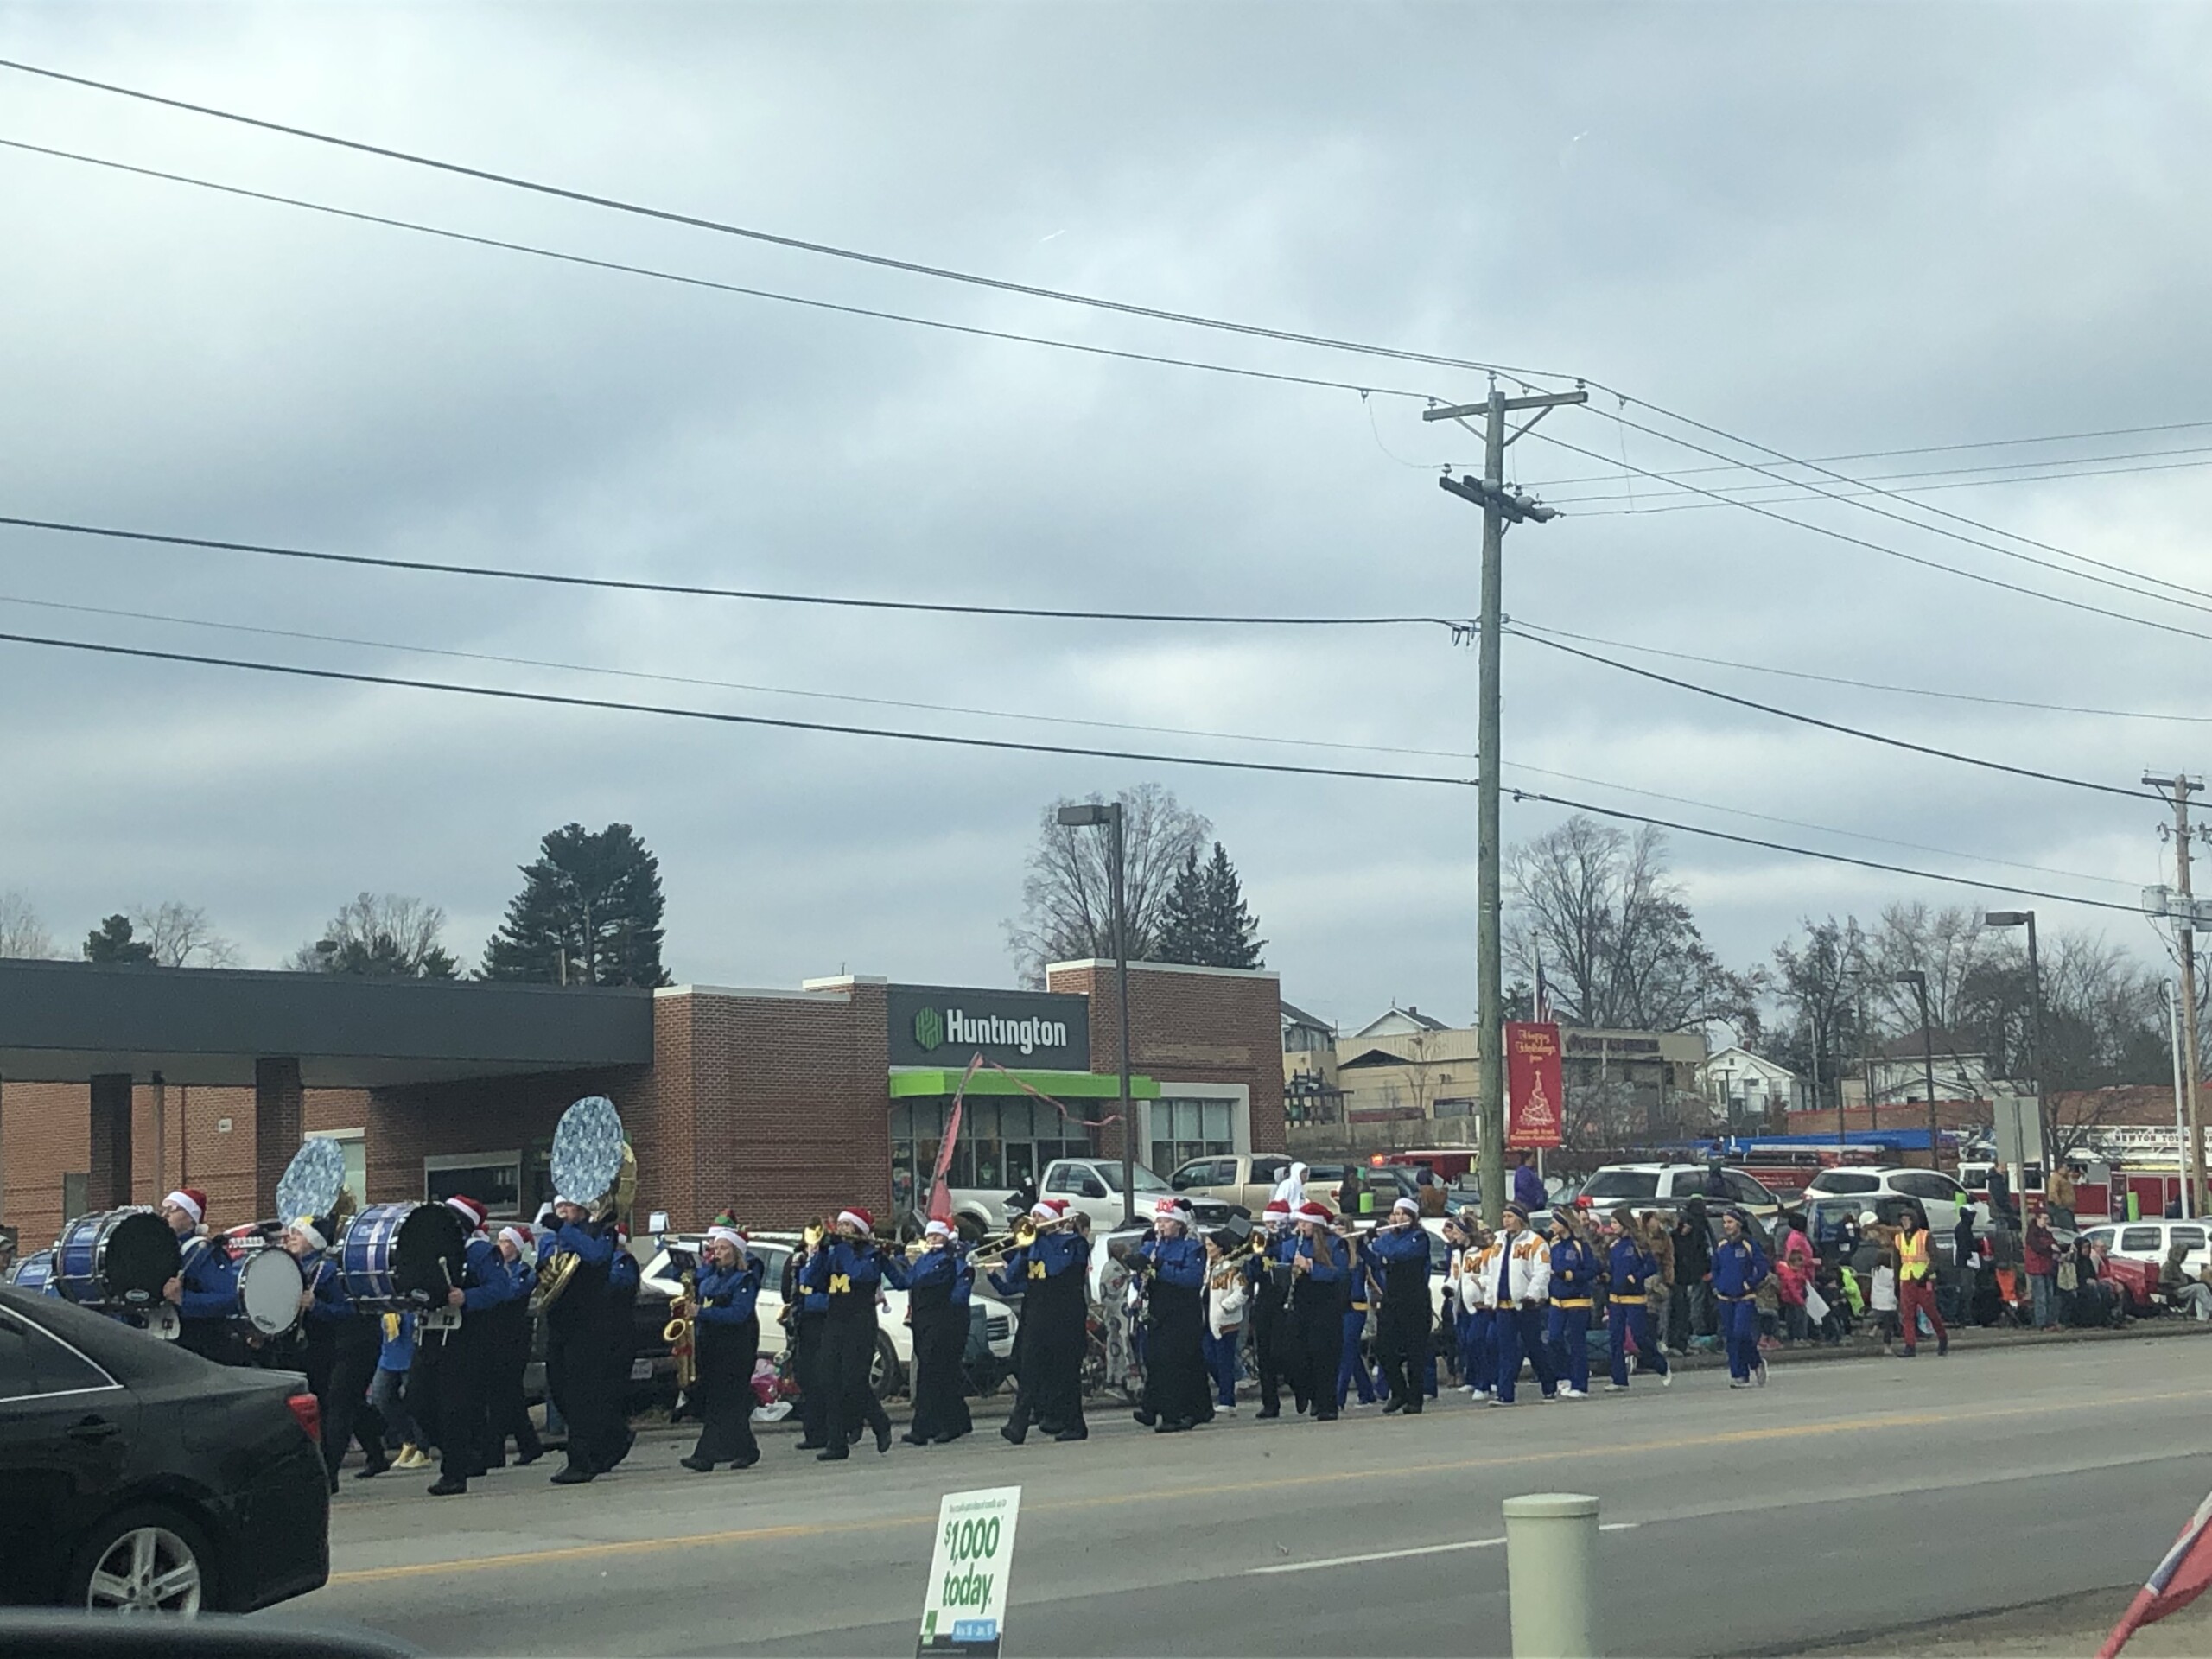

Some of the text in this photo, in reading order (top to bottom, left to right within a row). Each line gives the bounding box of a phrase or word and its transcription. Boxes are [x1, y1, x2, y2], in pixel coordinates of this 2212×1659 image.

[947, 1009, 1067, 1055] Huntington
[1513, 1243, 1533, 1261] M
[1028, 1260, 1046, 1279] M
[1465, 1256, 1482, 1274] M
[829, 1274, 850, 1293] M
[943, 1562, 994, 1615] today.
